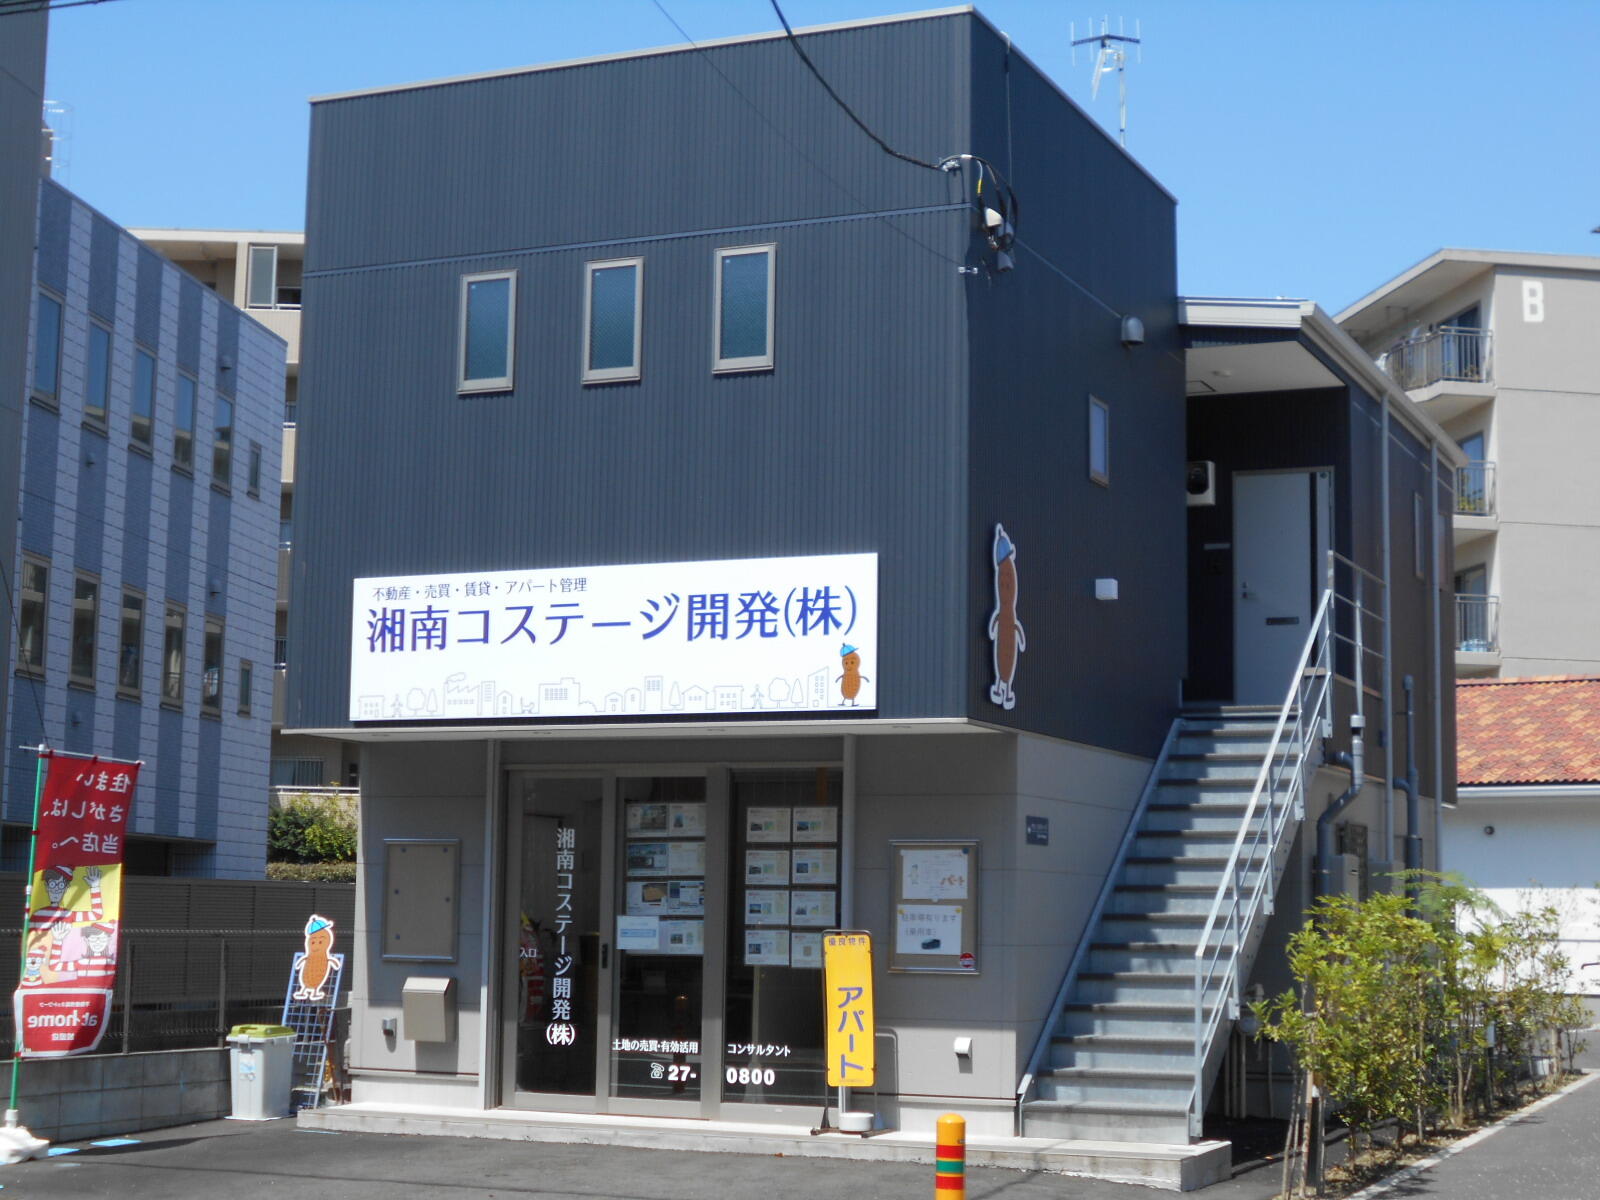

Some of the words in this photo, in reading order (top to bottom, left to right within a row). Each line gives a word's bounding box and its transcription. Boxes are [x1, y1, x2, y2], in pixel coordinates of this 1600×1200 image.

[1522, 280, 1544, 323] B
[372, 578, 588, 600] 不動産・売買・賃貸・アパート管理
[366, 584, 857, 653] 湘南コステージ開発(株)
[519, 948, 537, 958] 入口
[546, 828, 576, 1046] 湘南コステージ開発(株)
[837, 986, 865, 1080] アパート
[727, 1043, 791, 1058] コンサルタント
[726, 1067, 775, 1086] 0800
